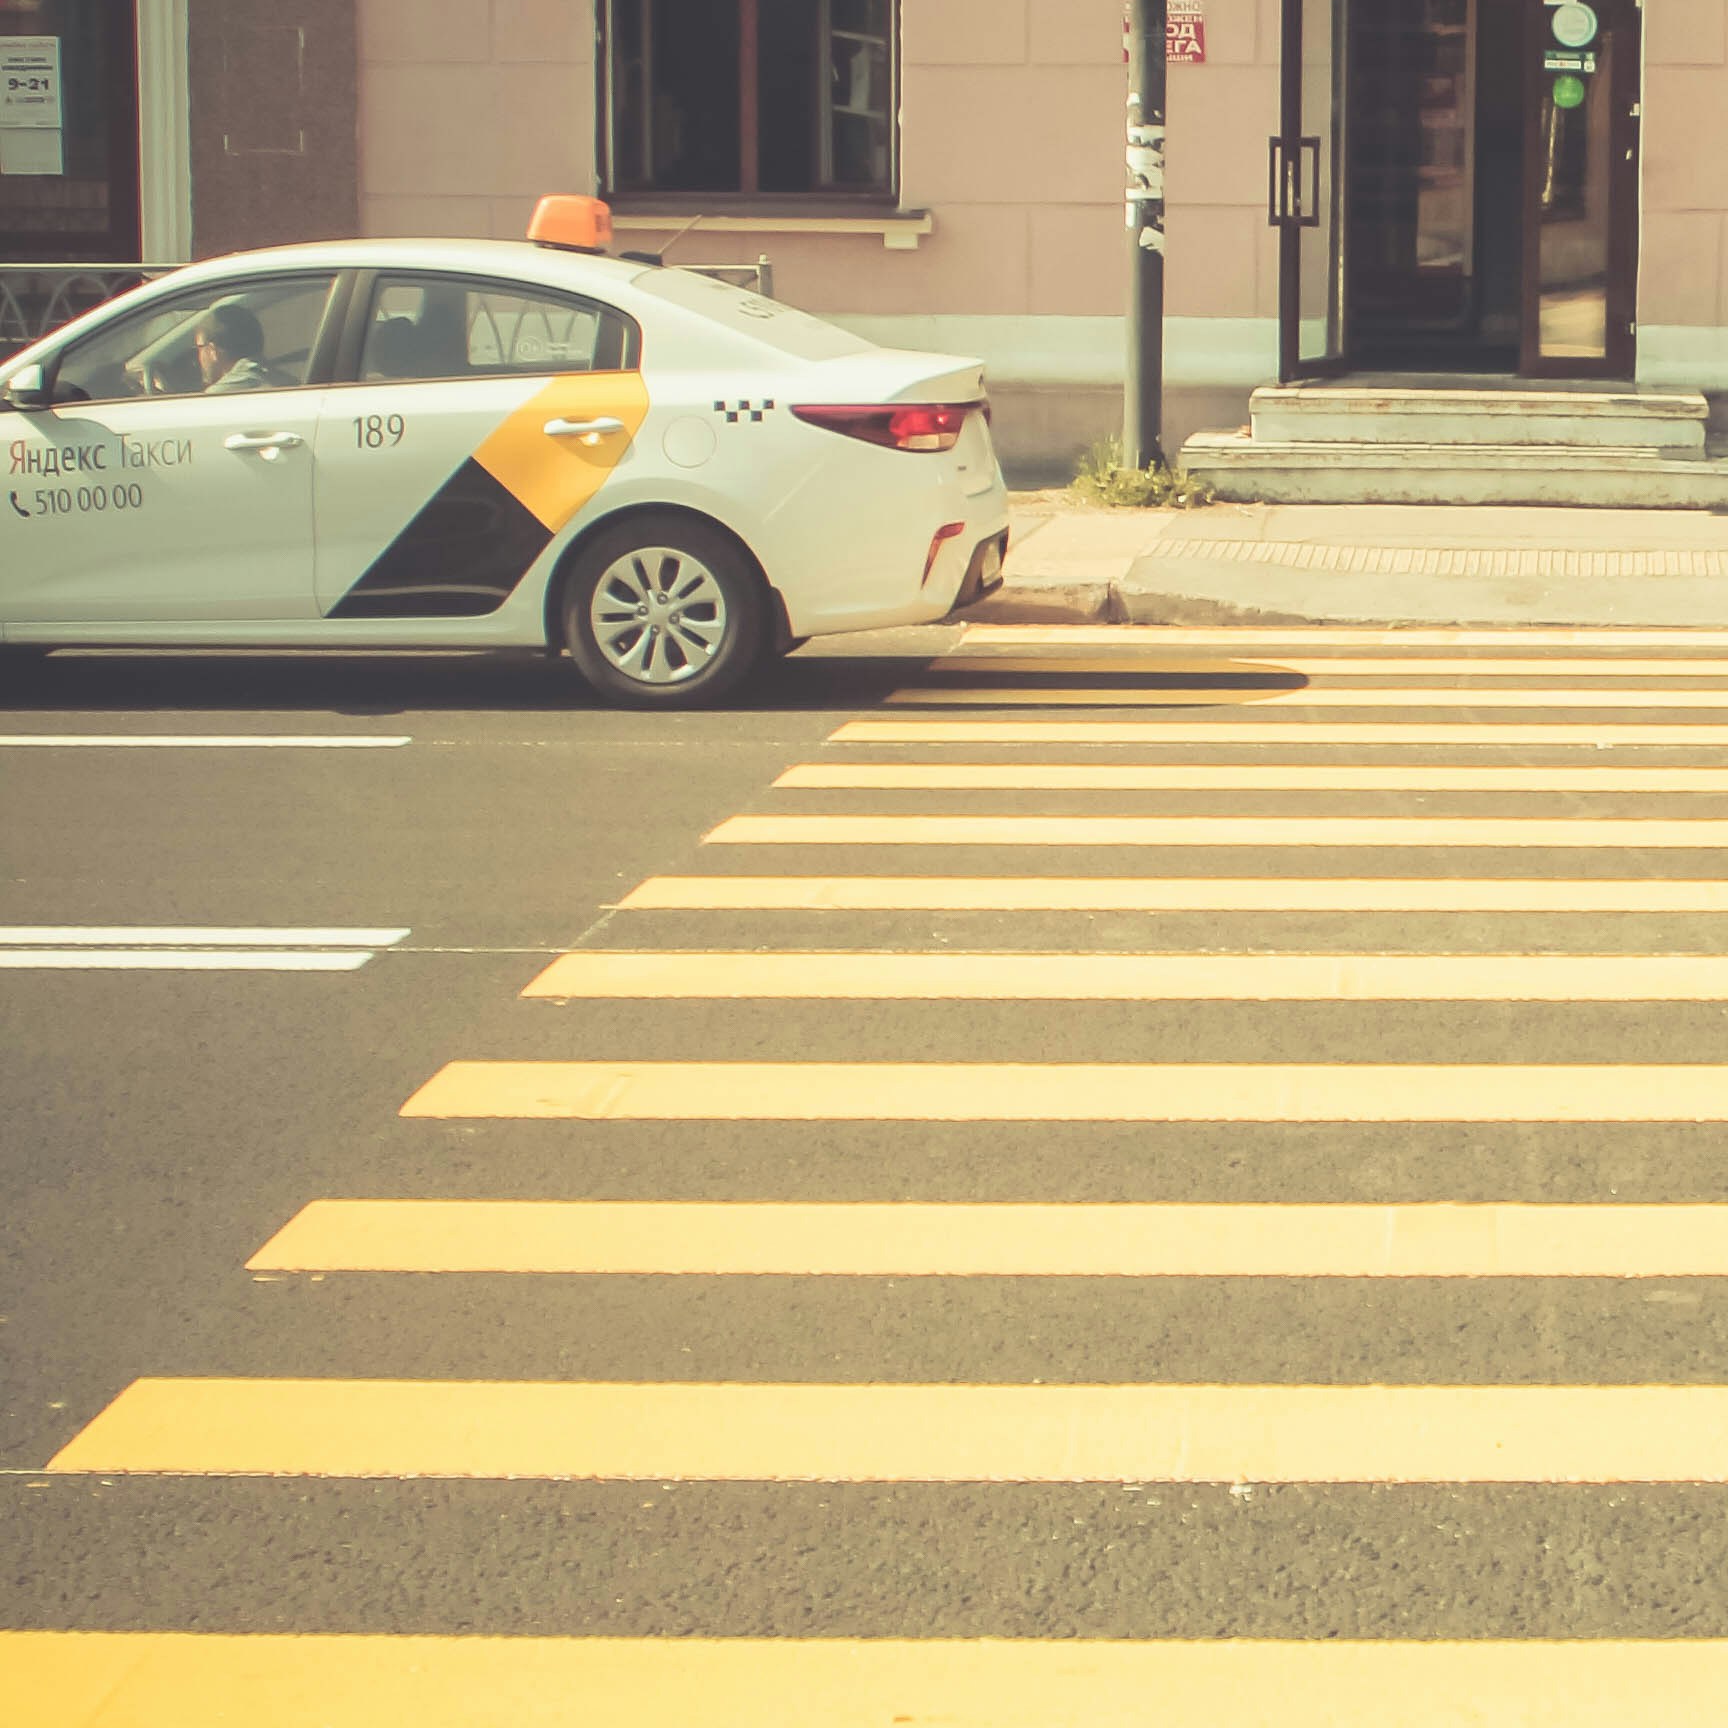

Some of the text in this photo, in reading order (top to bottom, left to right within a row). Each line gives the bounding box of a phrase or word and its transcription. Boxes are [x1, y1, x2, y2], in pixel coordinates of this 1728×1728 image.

[8, 77, 49, 91] 9-21
[352, 413, 405, 449] 189
[9, 432, 193, 477] Яндекс Такси
[35, 482, 143, 515] 510 00 00
